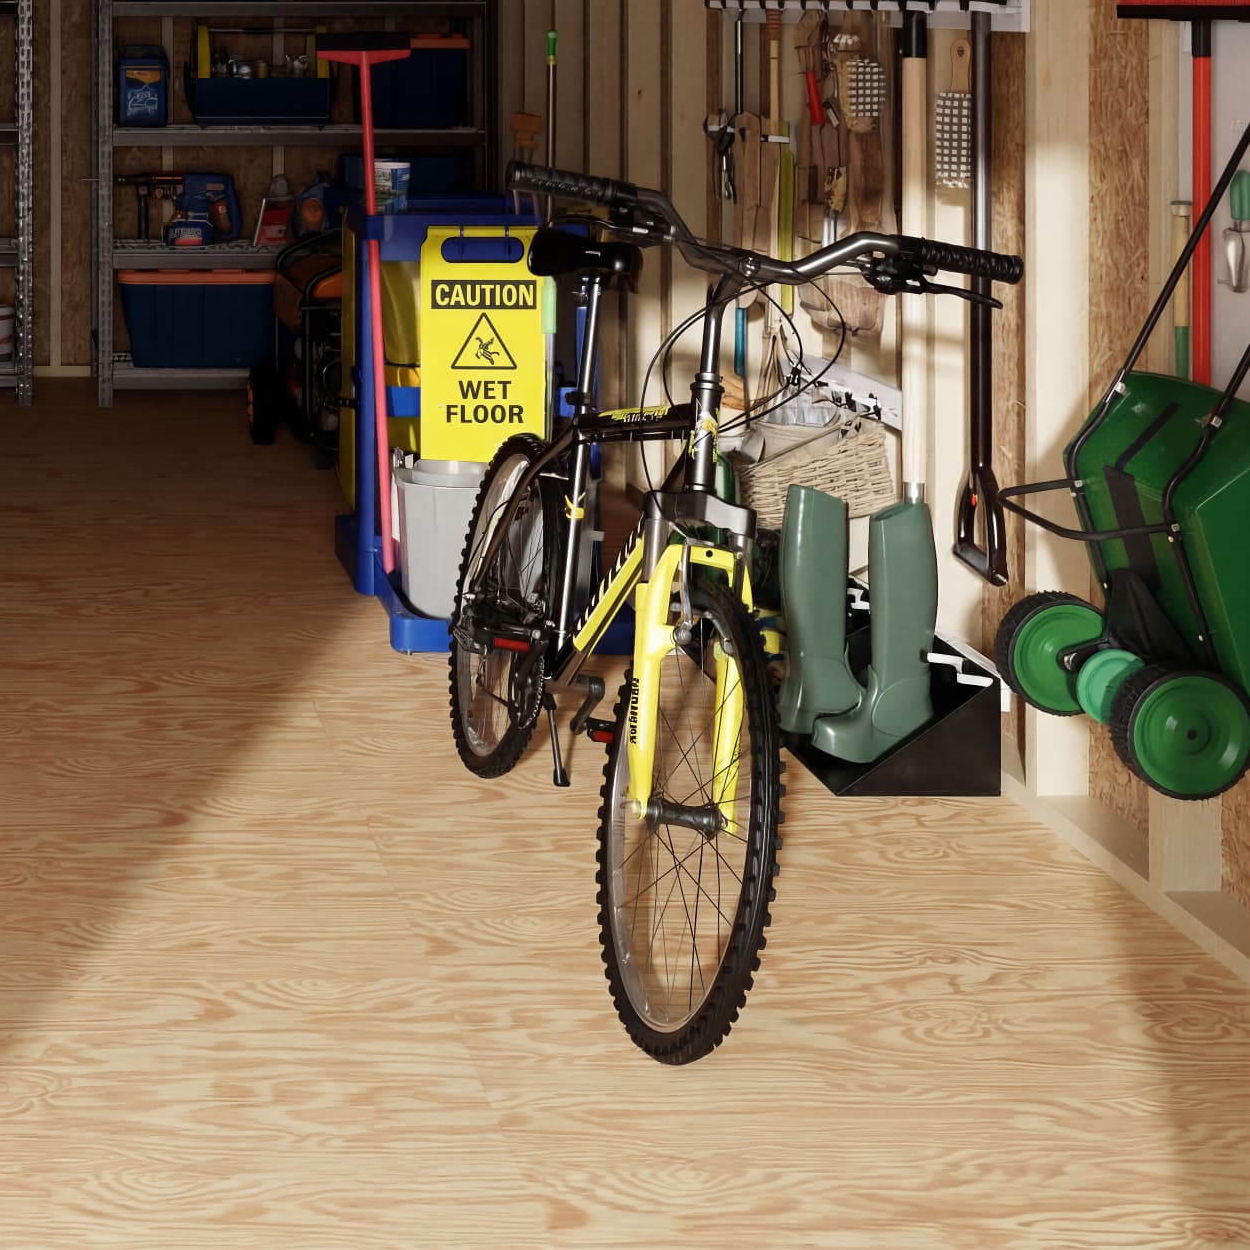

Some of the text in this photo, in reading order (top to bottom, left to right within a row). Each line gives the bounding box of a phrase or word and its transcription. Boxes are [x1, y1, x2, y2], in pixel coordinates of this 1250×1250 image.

[435, 283, 534, 307] CAUTION
[458, 380, 512, 400] WET
[446, 404, 524, 424] FLOOR
